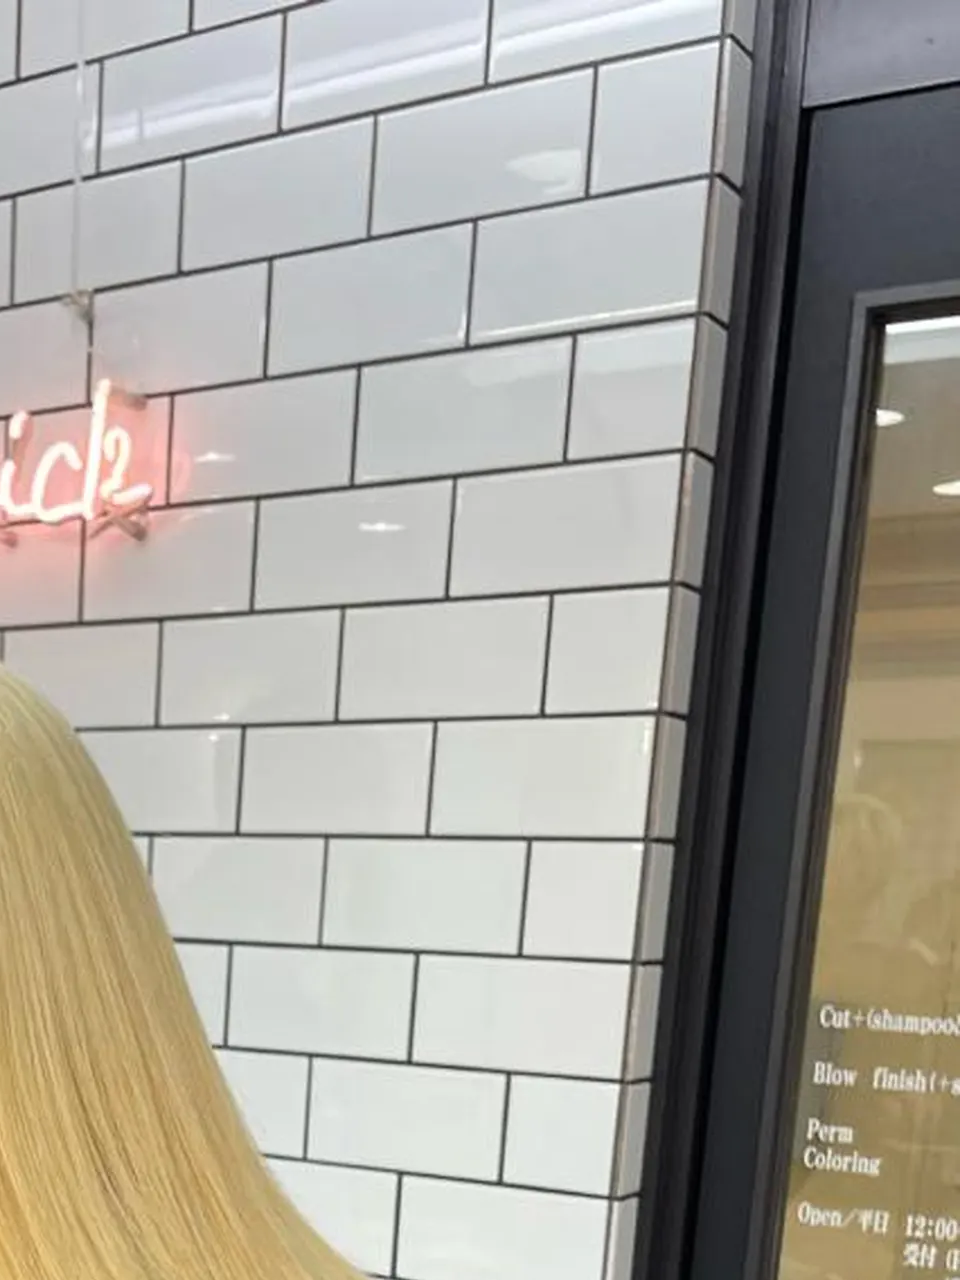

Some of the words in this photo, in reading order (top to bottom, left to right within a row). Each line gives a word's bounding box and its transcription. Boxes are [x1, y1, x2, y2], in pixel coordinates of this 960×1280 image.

[813, 1061, 858, 1087] Blow
[806, 1118, 854, 1144] Perm
[803, 1147, 882, 1176] Coloring
[905, 1213, 960, 1242] 12:00
